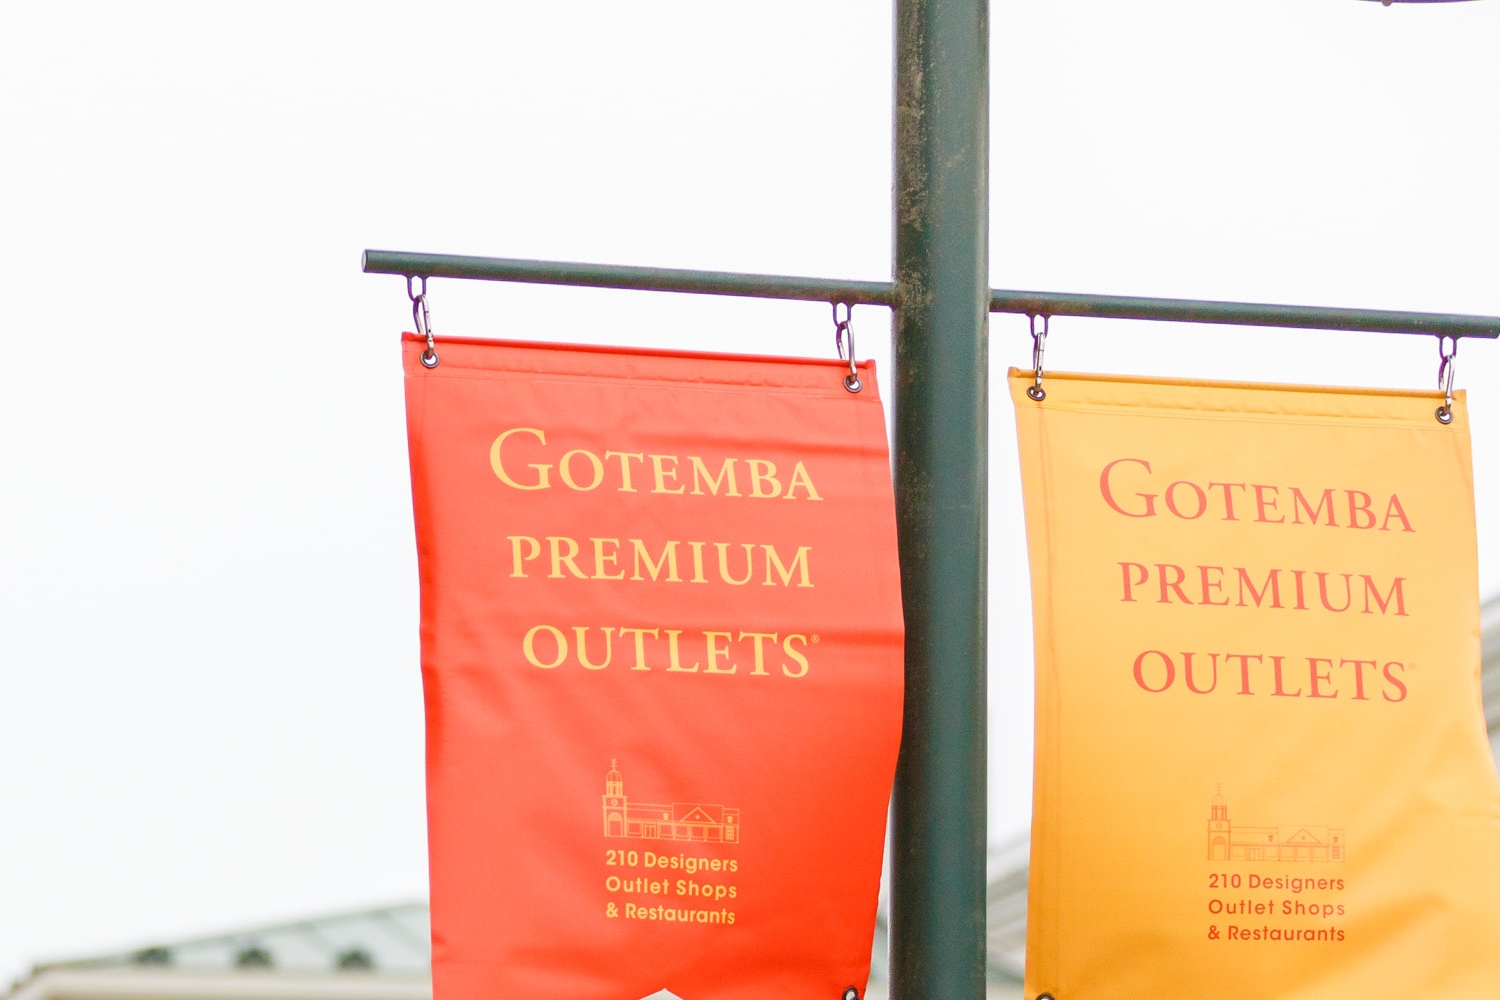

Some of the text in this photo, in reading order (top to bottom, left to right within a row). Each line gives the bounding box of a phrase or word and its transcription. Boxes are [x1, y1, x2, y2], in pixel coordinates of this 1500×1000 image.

[489, 427, 824, 501] GOTEMBA
[1100, 458, 1417, 533] GOTEMBA
[507, 536, 815, 588] PREMIUM
[1117, 561, 1410, 617] PREMIUM
[1132, 650, 1409, 703] OUTLETS
[605, 850, 739, 874] 210 Designers
[605, 876, 737, 901] Outlet Shops
[1209, 873, 1345, 894] 210 Designers
[605, 902, 736, 925] & Restaurants
[1208, 899, 1346, 919] Outlet Shops
[1207, 925, 1345, 942] & Restaurants
